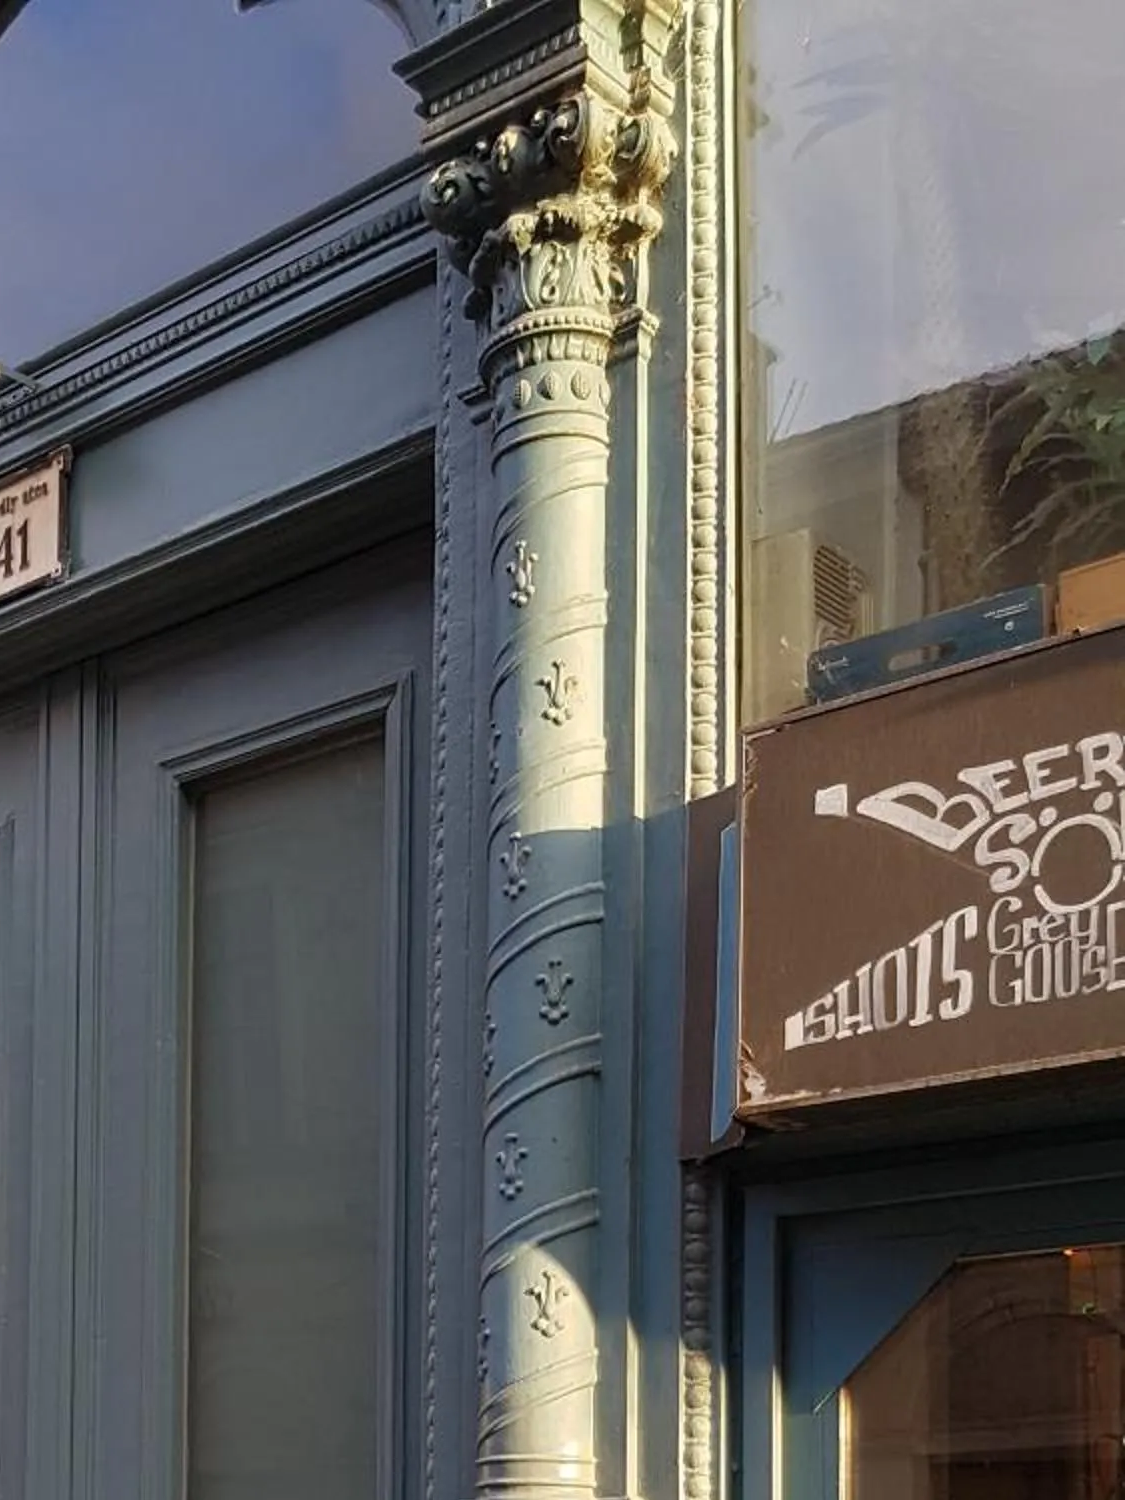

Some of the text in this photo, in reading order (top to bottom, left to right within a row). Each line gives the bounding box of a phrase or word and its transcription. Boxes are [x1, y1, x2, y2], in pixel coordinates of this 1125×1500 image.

[856, 731, 1125, 853] BEER
[801, 905, 978, 1045] SHOTS
[987, 896, 1100, 952] Grey
